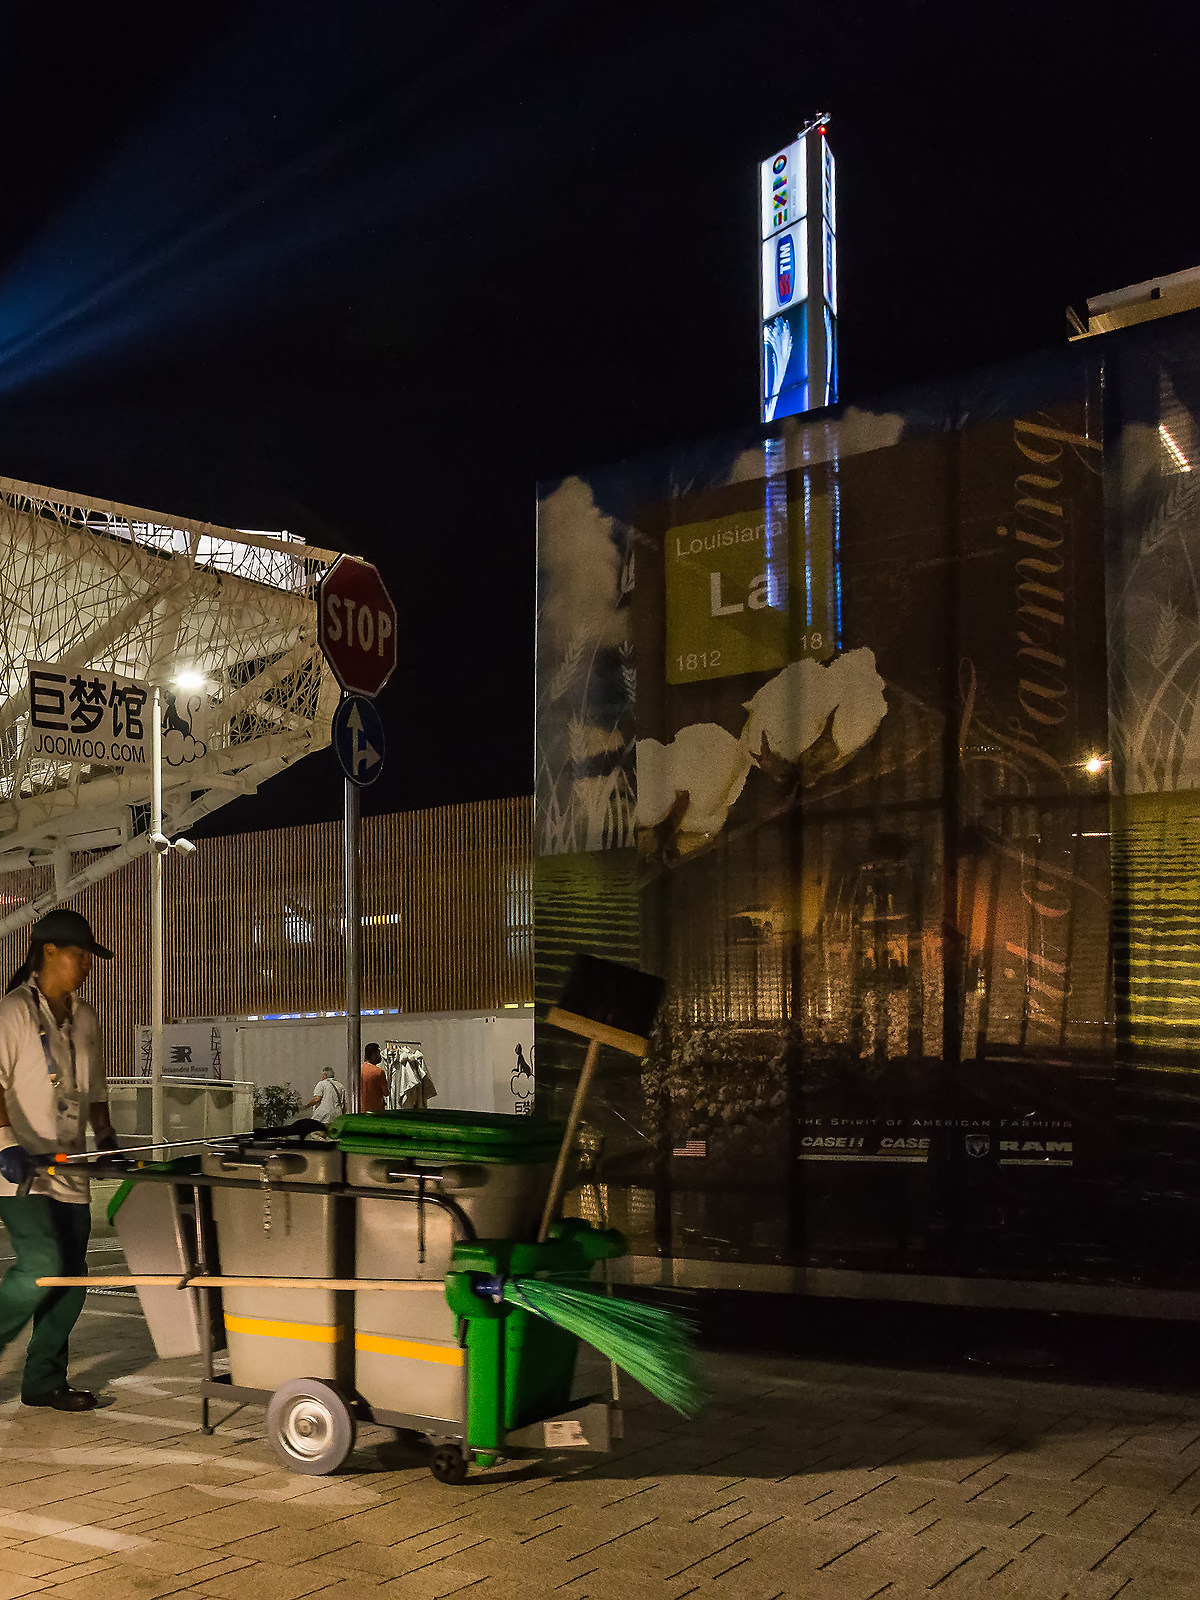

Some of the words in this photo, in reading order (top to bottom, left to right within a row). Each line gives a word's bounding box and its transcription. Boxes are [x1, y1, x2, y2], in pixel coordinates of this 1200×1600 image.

[779, 242, 792, 275] TIM
[676, 520, 783, 557] Louisiana
[710, 572, 780, 617] La
[327, 593, 392, 657] STOP
[801, 632, 823, 651] 18
[676, 650, 721, 672] 1812
[30, 671, 147, 739] 巨梦馆
[34, 735, 145, 763] JOOMOO.COM
[880, 1137, 931, 1149] CASE
[1000, 1141, 1073, 1152] RAM
